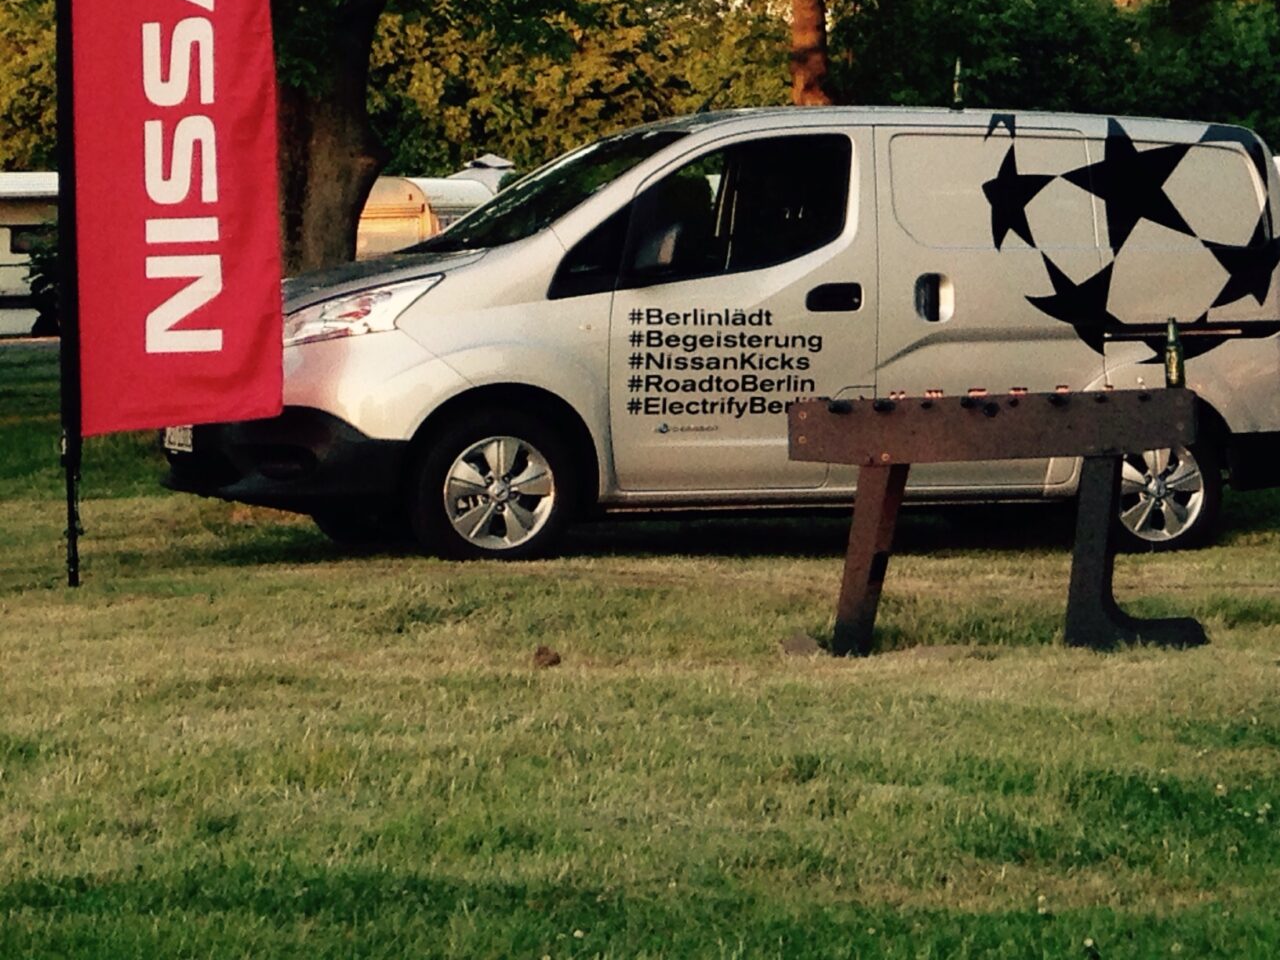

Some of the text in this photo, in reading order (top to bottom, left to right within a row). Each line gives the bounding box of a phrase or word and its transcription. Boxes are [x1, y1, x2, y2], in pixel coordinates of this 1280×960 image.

[627, 308, 773, 326] #Berlinlädt
[627, 330, 823, 353] #Begeisterung
[627, 352, 811, 371] #NissanKicks
[627, 375, 815, 393] #RoadtoBerlin
